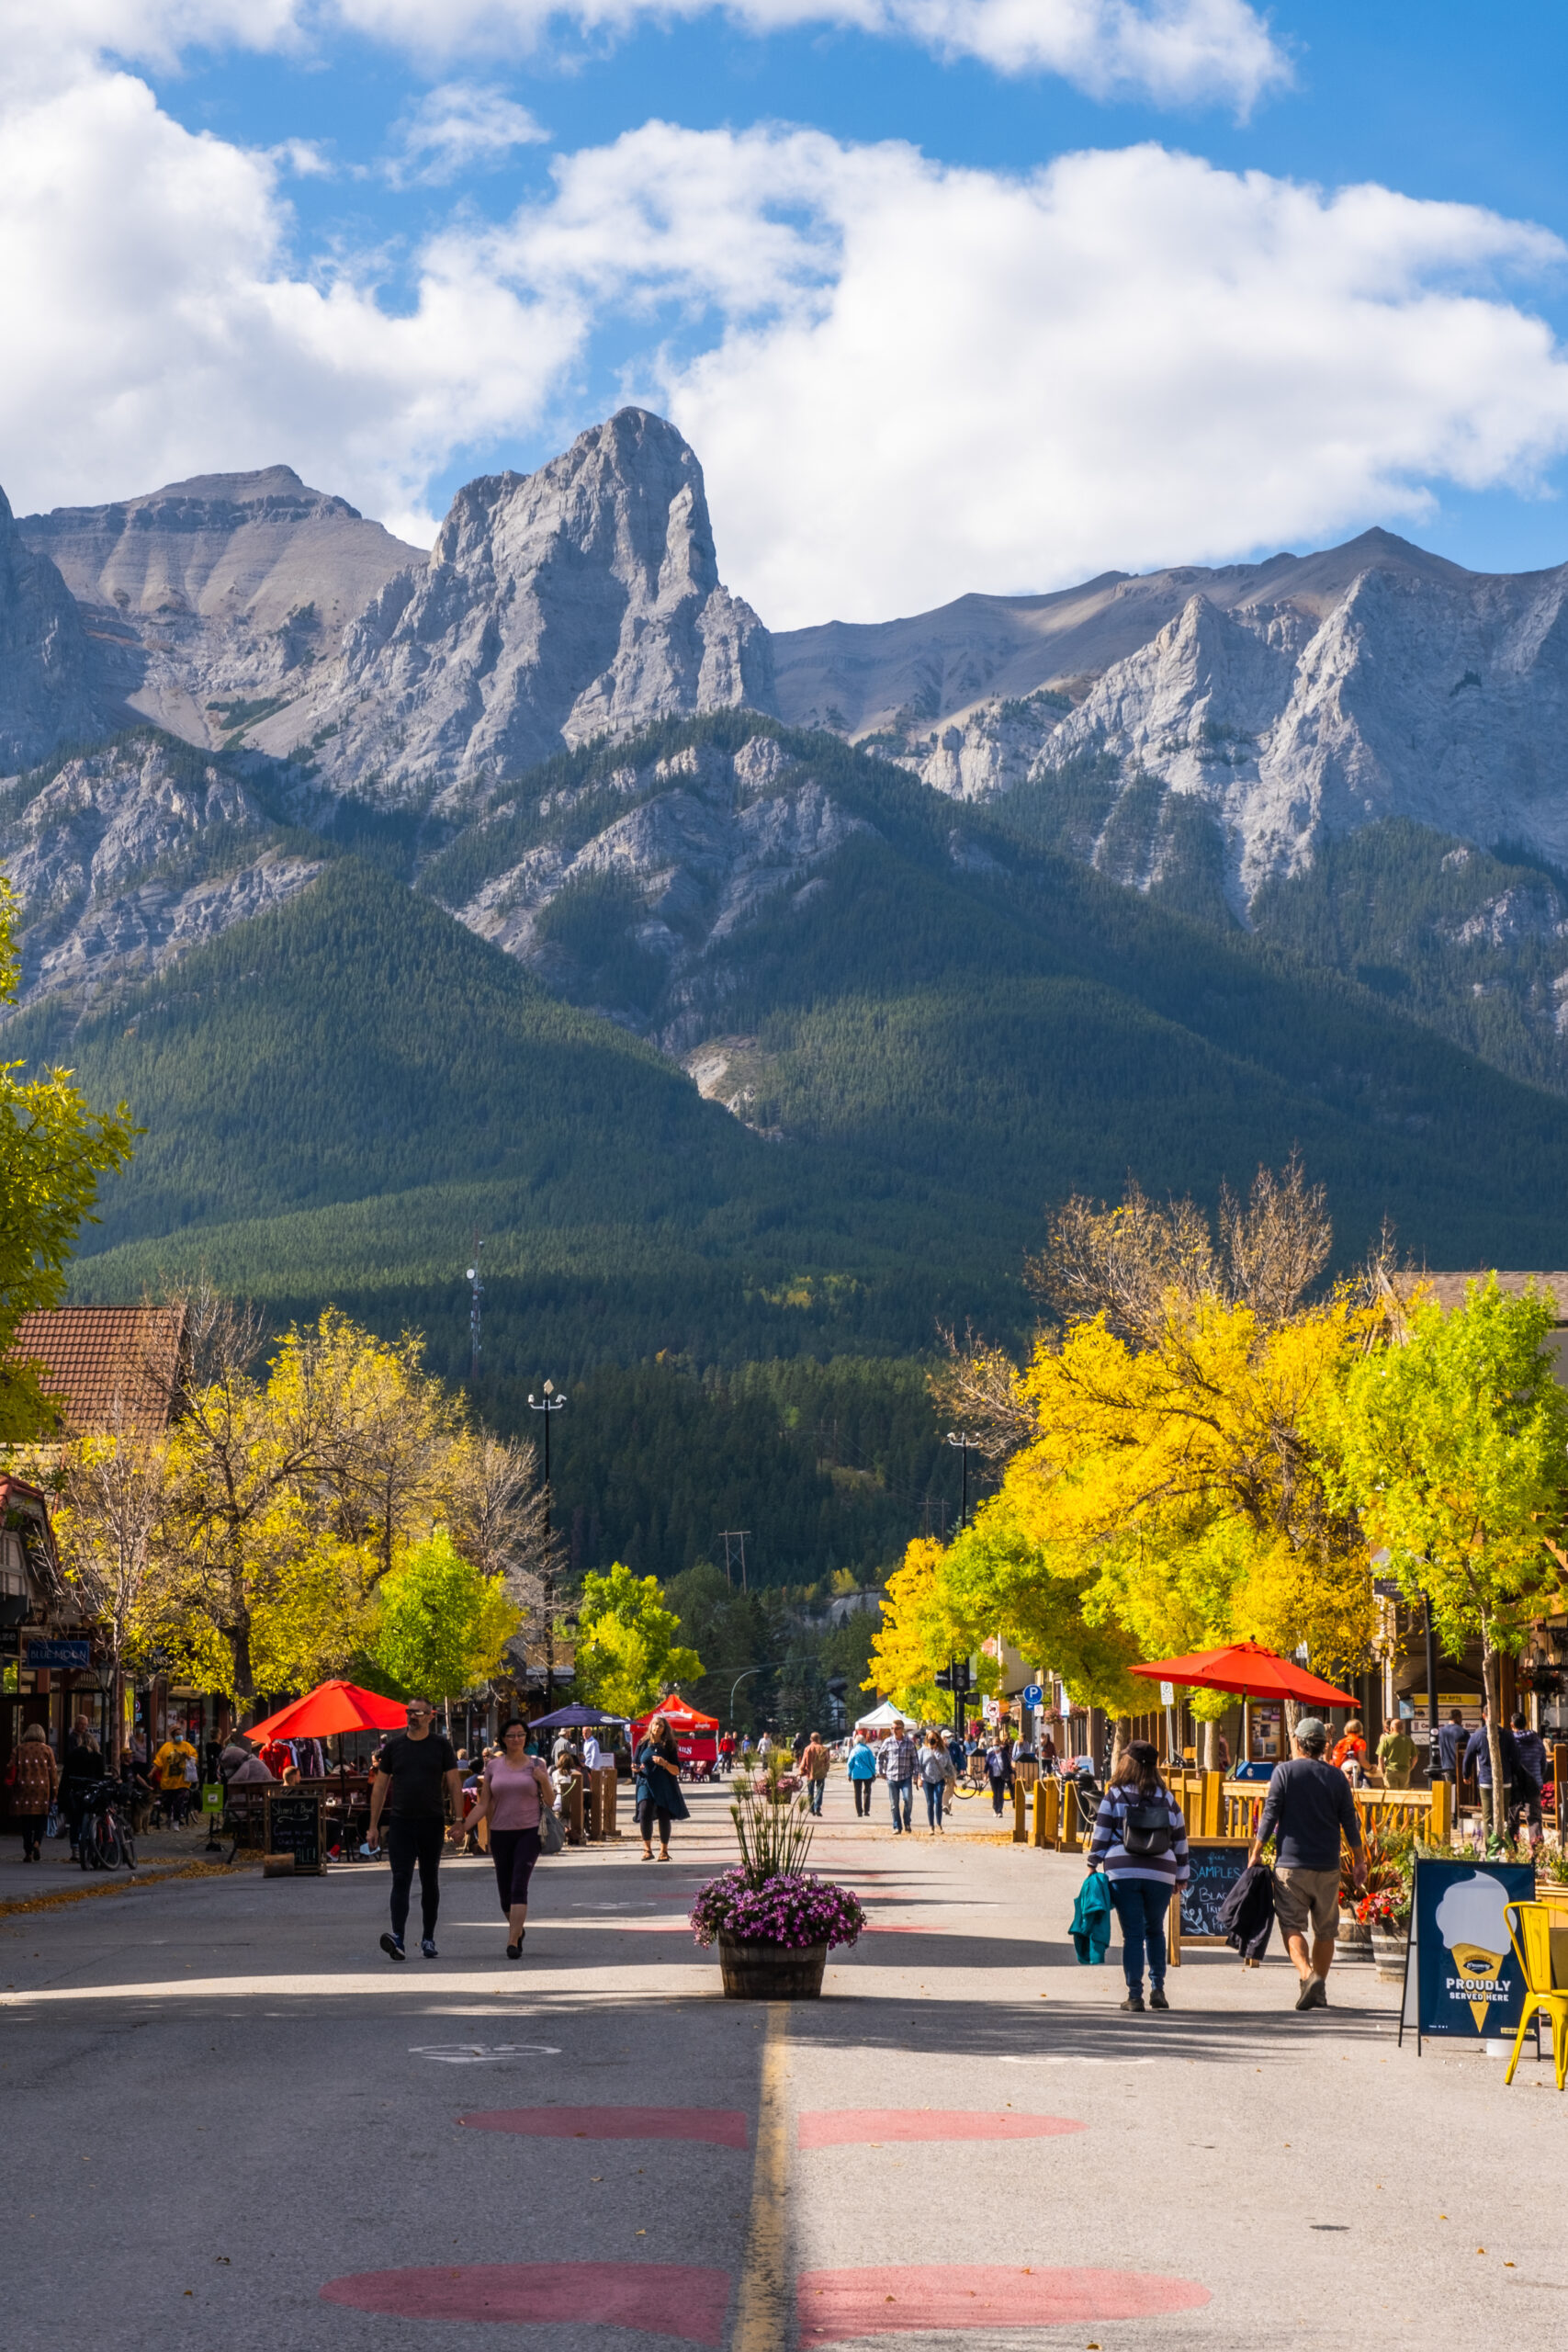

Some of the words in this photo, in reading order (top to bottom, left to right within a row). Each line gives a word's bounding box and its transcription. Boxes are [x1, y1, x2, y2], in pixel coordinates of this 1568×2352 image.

[30, 1649, 52, 1659] BLUE
[55, 1649, 86, 1659] MOON
[1029, 1687, 1038, 1698] P
[1207, 1852, 1225, 1864] free
[1189, 1859, 1241, 1882] SAMPLES
[1199, 1887, 1227, 1902] BLAC
[1446, 1977, 1511, 1992] PROUDLY
[1450, 1992, 1483, 2001] SERVED
[1485, 1993, 1509, 2002] HERE
